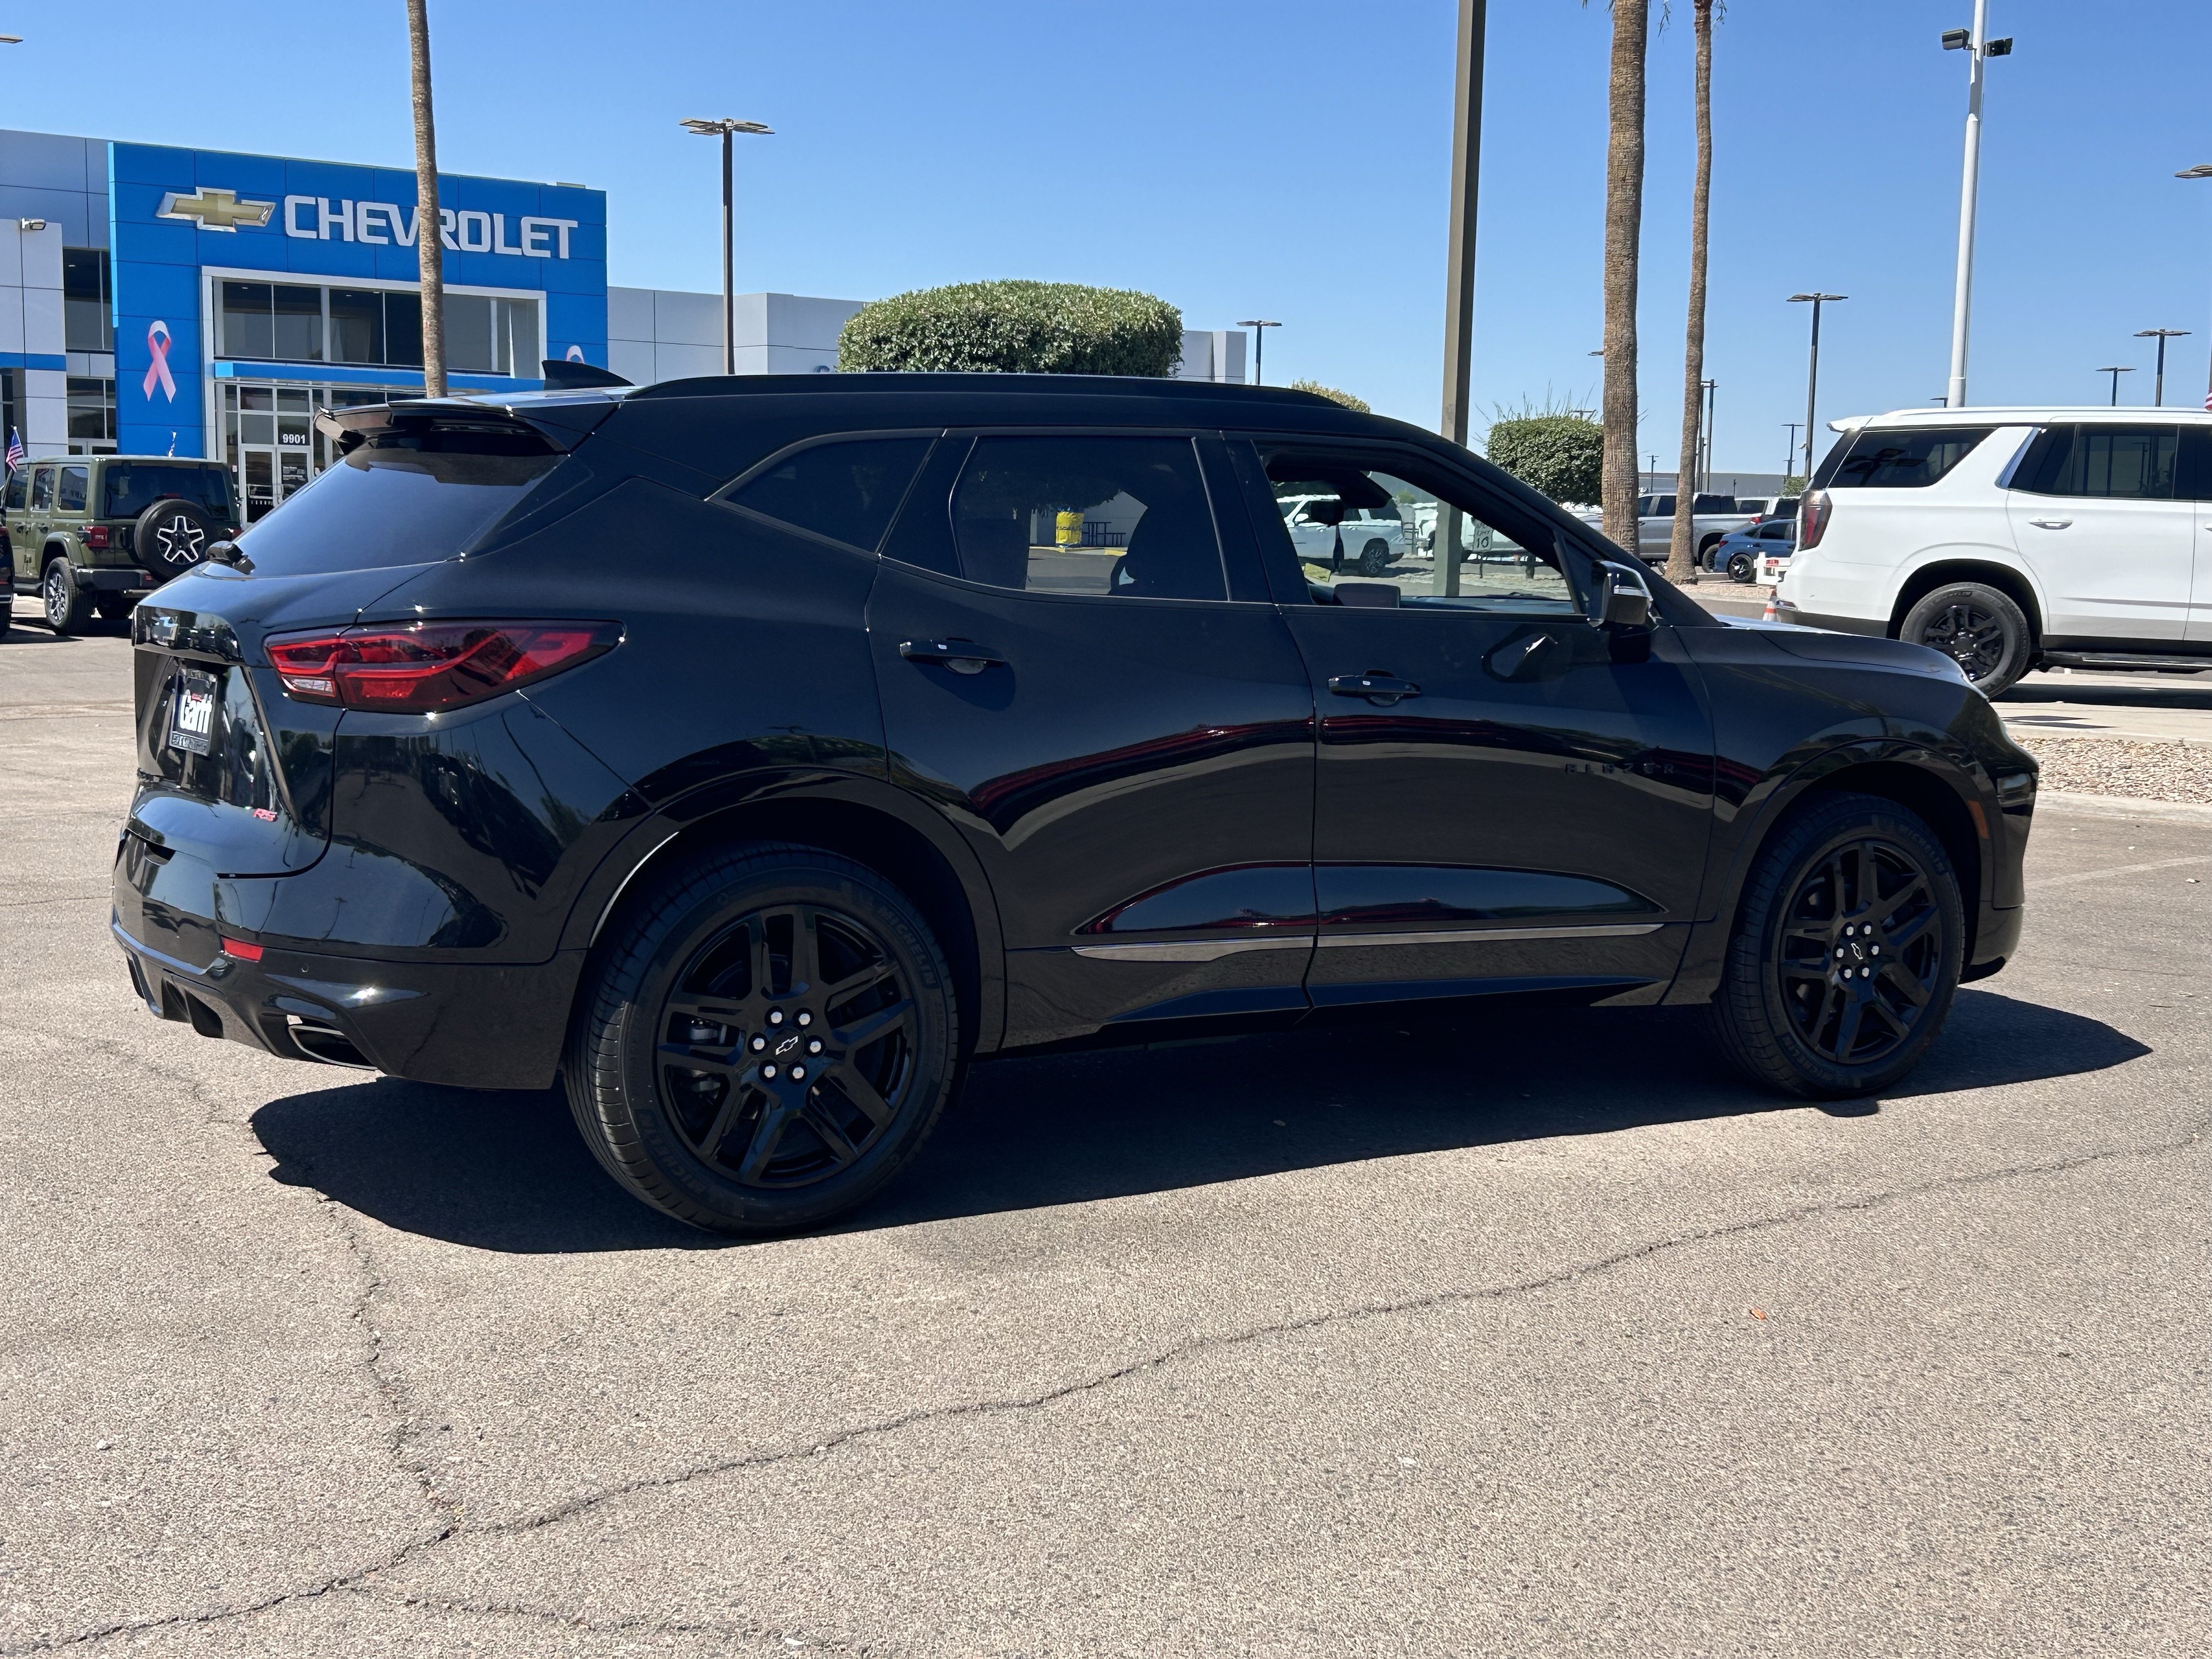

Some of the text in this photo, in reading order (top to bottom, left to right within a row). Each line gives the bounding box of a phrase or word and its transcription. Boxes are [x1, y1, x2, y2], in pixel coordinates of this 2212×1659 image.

[284, 195, 579, 259] CHEVROLET
[283, 433, 306, 444] 9901
[1477, 537, 1489, 549] 10
[877, 905, 937, 985] MICHELIN
